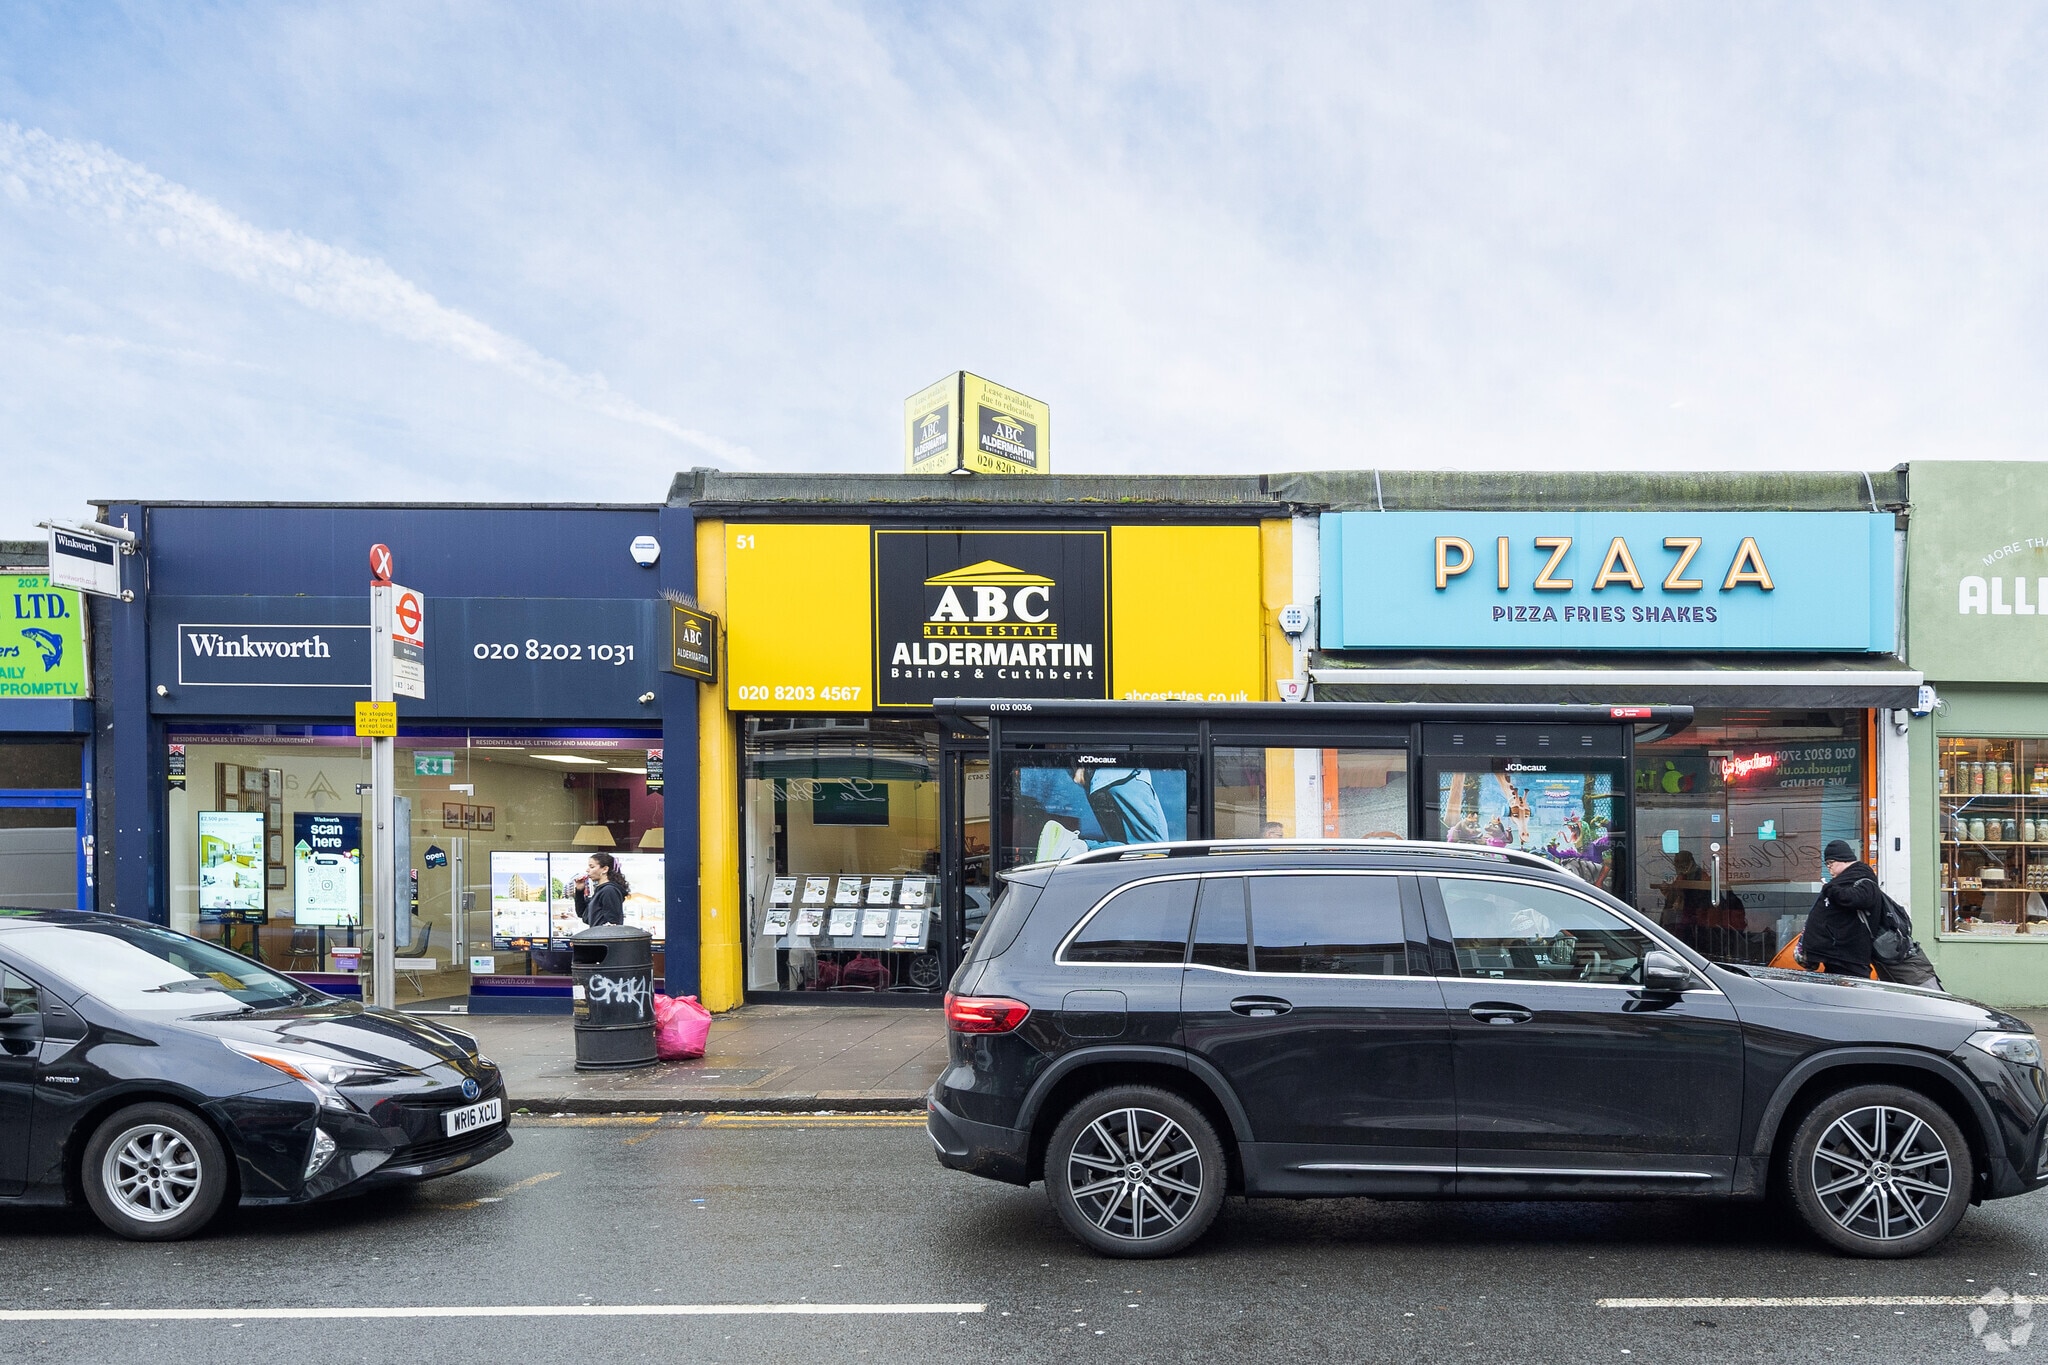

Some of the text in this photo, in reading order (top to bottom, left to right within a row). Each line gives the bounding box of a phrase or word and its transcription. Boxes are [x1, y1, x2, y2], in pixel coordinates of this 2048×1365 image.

[981, 394, 994, 404] due
[1003, 402, 1035, 419] relocation
[983, 384, 1032, 410] Lease available
[922, 420, 940, 440] ABC
[995, 422, 1022, 442] ABC
[982, 434, 1034, 461] ALDERMARTIN
[978, 454, 993, 468] 020
[996, 460, 1016, 474] 8203
[57, 534, 97, 553] Winkworth
[736, 535, 756, 550] 51
[1982, 537, 2048, 567] MORE TH
[376, 548, 390, 578] X
[1435, 536, 1776, 592] PIZAZA
[18, 578, 38, 588] 202
[13, 594, 71, 619] LTD.
[930, 586, 1050, 624] ABC
[1492, 606, 1718, 624] PIZZA FRIES SHAKES
[683, 628, 702, 646] ABC
[924, 626, 1058, 637] REAL ESTATE
[187, 633, 331, 659] Winkworth
[473, 638, 635, 666] 020 8202 1031
[892, 642, 1093, 667] ALDERMARTIN
[677, 648, 709, 665] ALDERMARTIN
[891, 668, 1094, 680] Baines & Cuthbert
[0, 682, 78, 695] PROMPTLY
[738, 686, 862, 701] 020 8203 4567
[1078, 755, 1116, 764] JCDecaux
[1505, 763, 1547, 772] JCDecaux
[311, 825, 343, 835] scan
[312, 835, 342, 848] here
[426, 852, 445, 861] open
[454, 1102, 497, 1131] WR16 XCU
